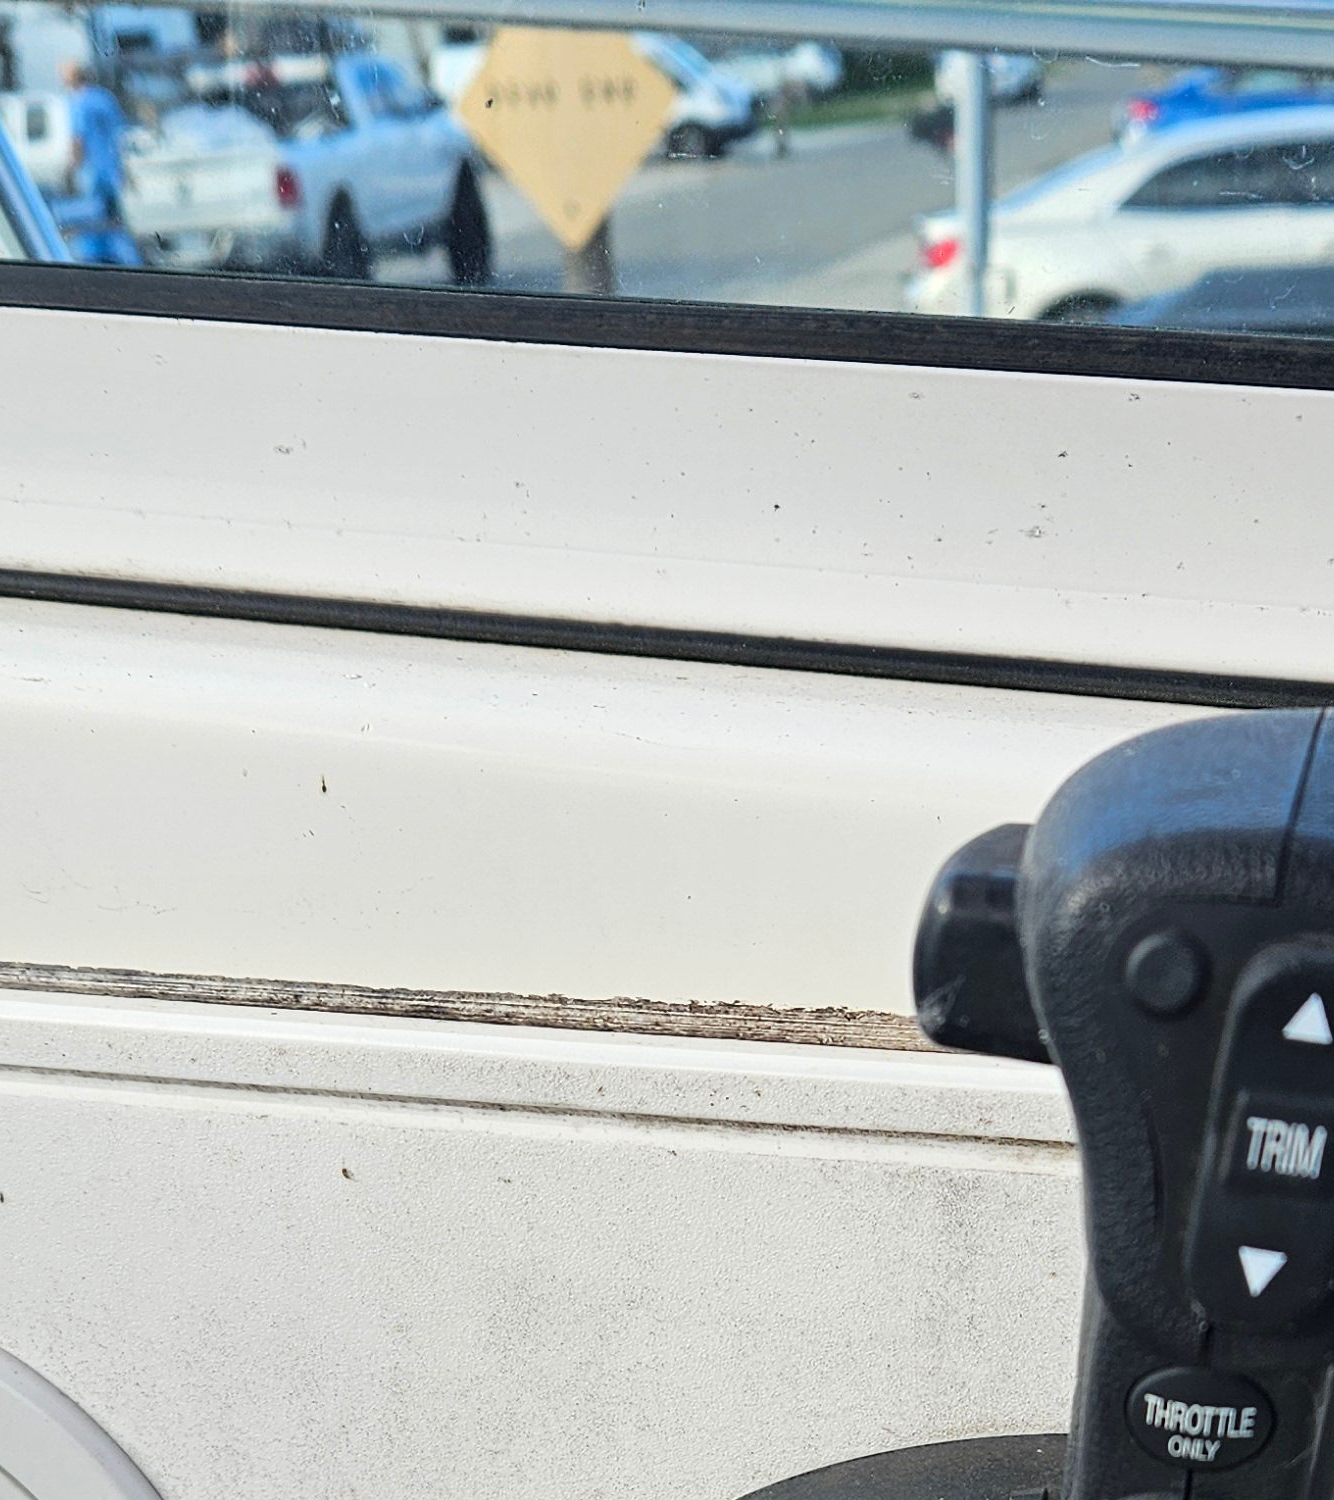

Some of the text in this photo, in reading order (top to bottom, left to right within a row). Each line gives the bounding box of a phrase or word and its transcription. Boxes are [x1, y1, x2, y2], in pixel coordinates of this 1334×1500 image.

[1245, 1115, 1328, 1180] TRIM
[1143, 1392, 1258, 1440] THROTTLE
[1167, 1437, 1222, 1463] ONLY
